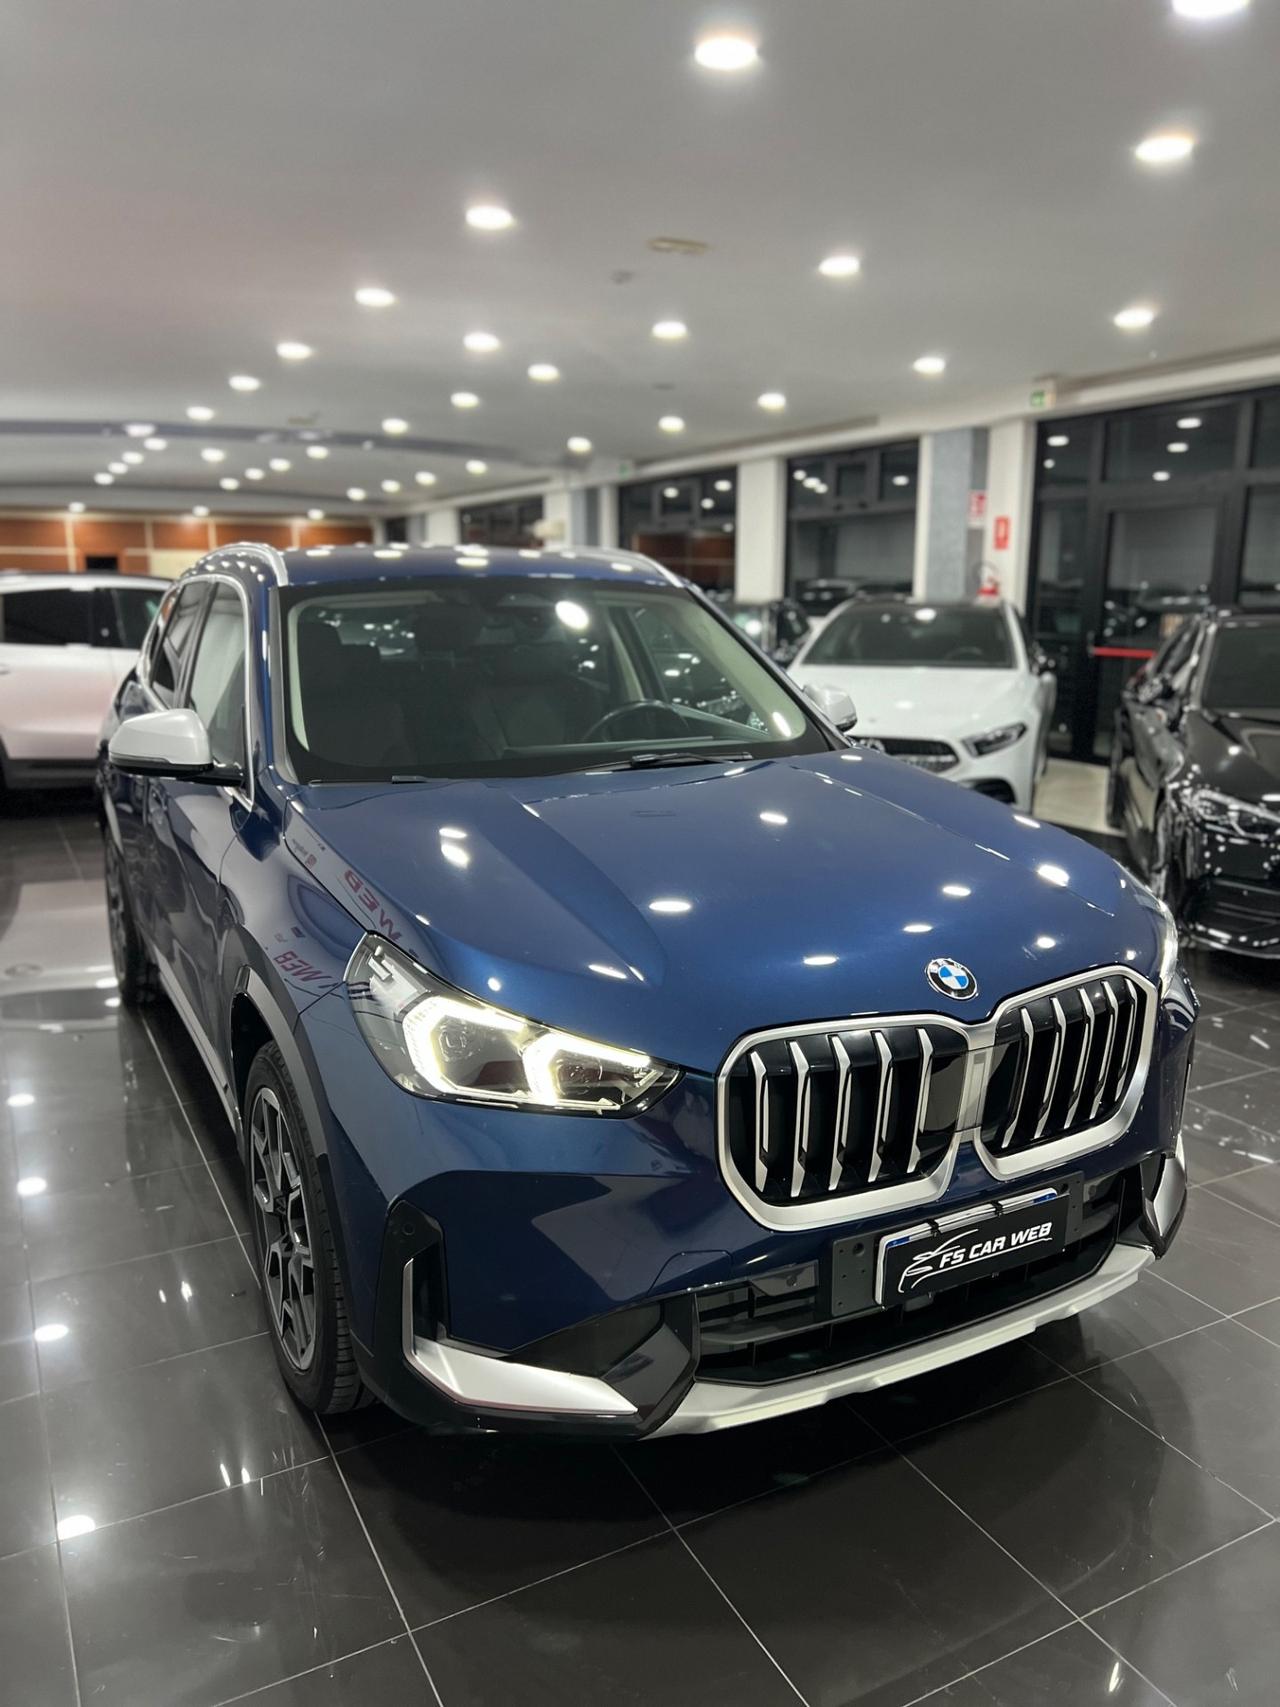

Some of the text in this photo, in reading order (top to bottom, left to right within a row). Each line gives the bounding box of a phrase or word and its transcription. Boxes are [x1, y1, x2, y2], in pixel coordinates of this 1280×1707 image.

[939, 1222, 1052, 1268] FS CAR WEB
